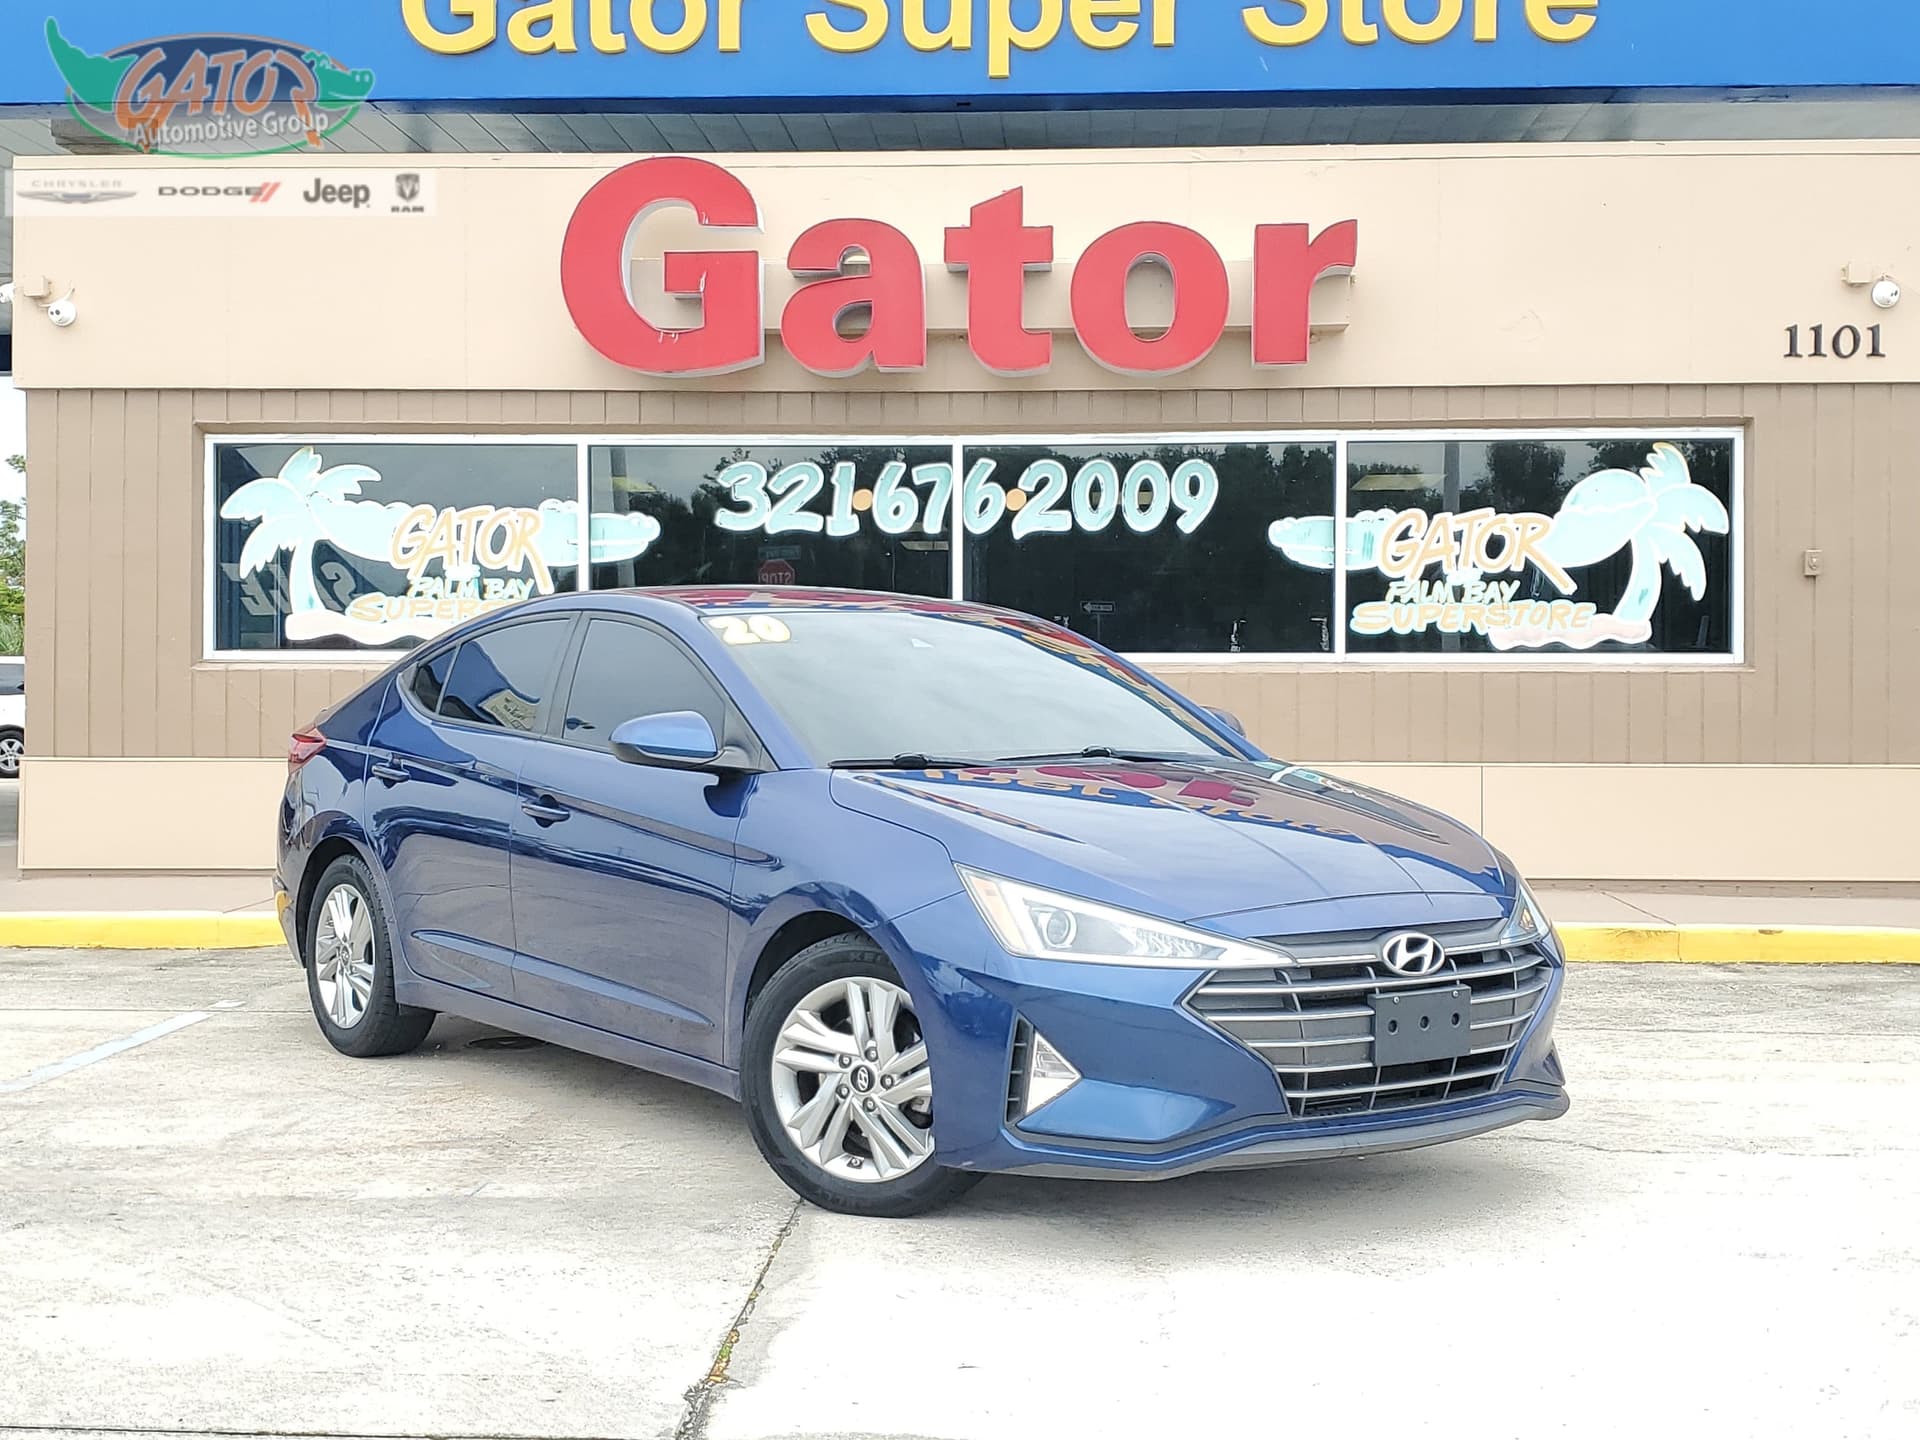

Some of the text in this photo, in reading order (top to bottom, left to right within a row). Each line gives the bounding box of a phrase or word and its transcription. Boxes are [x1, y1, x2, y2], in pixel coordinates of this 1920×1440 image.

[403, 0, 1597, 78] Gator Super Store
[560, 156, 1357, 379] Gator
[1783, 324, 1886, 359] 1101
[389, 504, 555, 594] GATOR
[1377, 508, 1578, 594] GATOR
[407, 576, 535, 600] PALM BAY
[1386, 579, 1521, 603] PALM BAY
[707, 614, 792, 645] 20
[1350, 599, 1598, 634] SUPERSTORE
